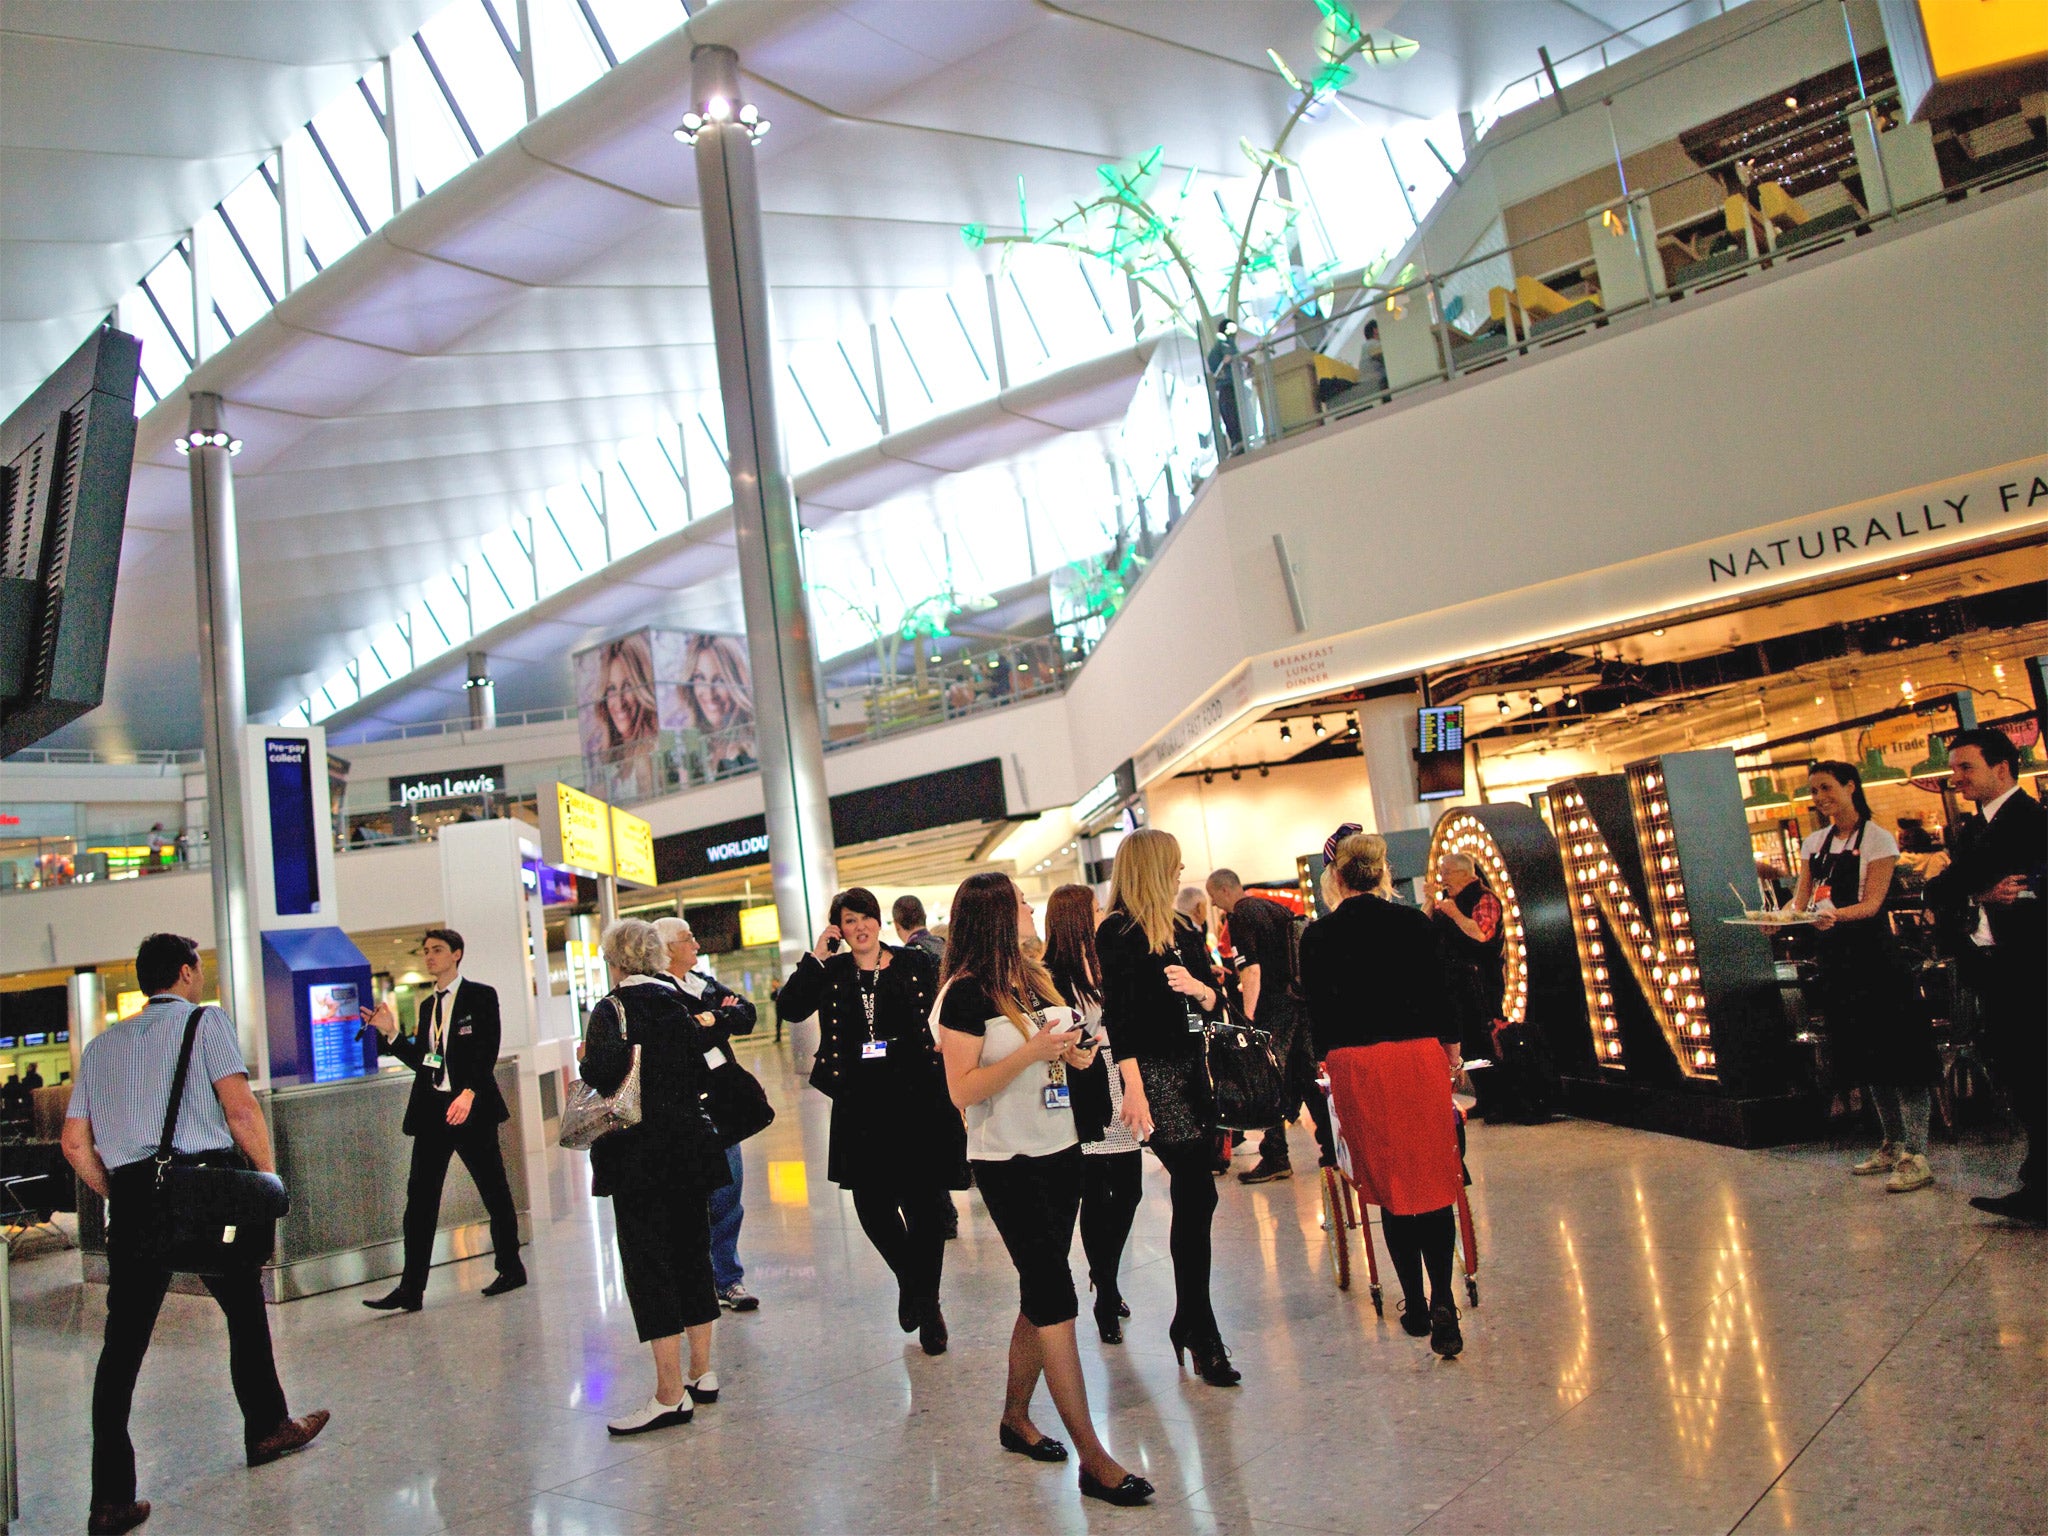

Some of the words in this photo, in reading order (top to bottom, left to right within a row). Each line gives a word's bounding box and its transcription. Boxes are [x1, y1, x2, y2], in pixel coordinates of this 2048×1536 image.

[1709, 495, 1969, 582] NATURALLY
[1999, 476, 2048, 514] FA
[1272, 646, 1334, 669] BREAKFAST
[1286, 660, 1326, 678] LUNCH
[1286, 672, 1329, 690] DINNER
[1202, 699, 1223, 729] FOOD
[268, 742, 306, 754] Pre-pay
[1892, 737, 1926, 755] Trade
[269, 753, 302, 763] collect
[400, 782, 442, 807] John
[444, 774, 496, 796] Lewis
[706, 834, 769, 862] WORLDDU
